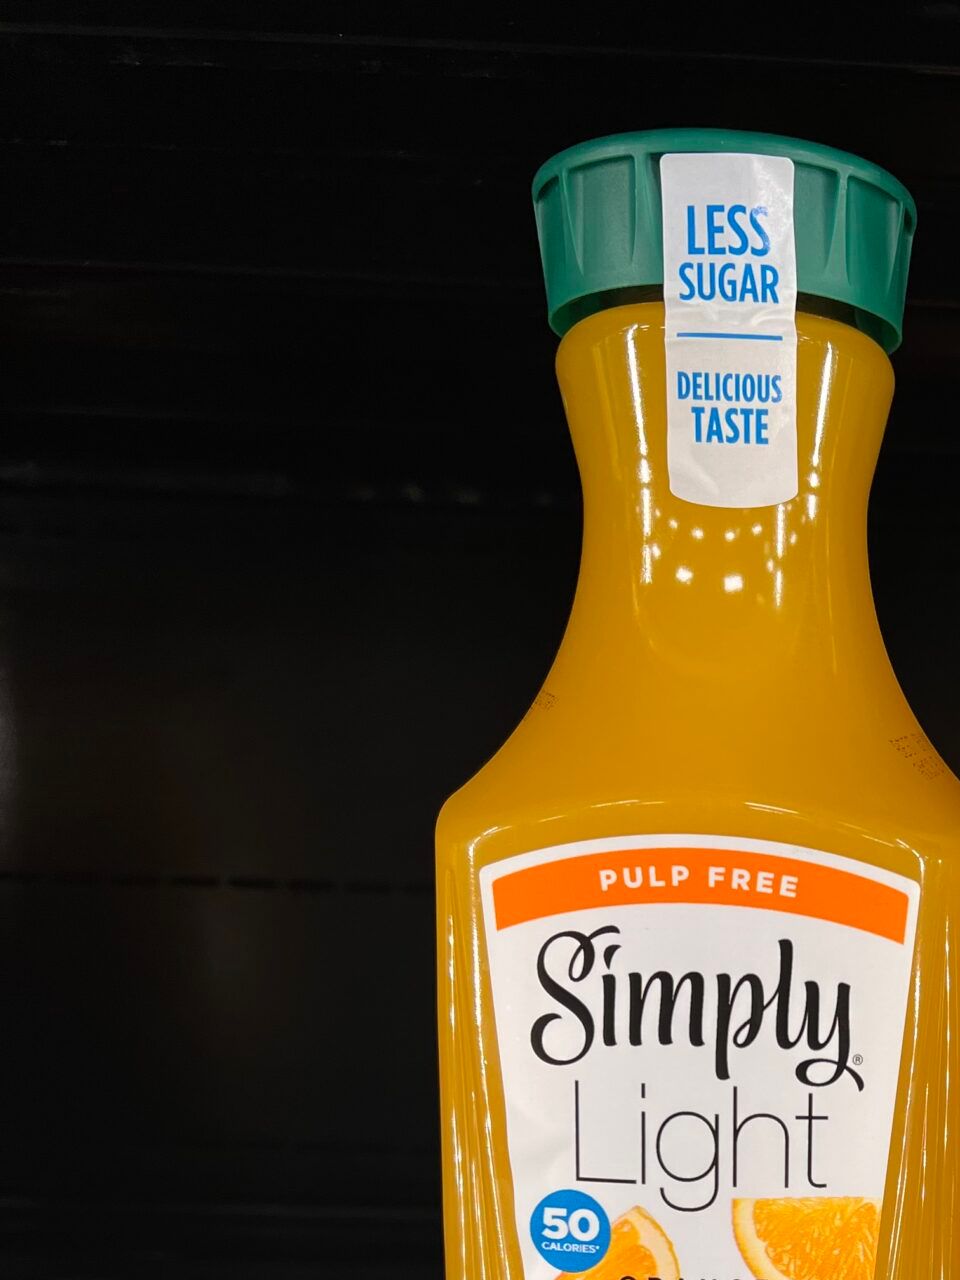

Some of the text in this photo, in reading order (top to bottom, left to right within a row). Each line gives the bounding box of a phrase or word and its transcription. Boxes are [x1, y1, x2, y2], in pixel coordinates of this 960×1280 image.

[687, 204, 771, 257] LESS
[679, 262, 779, 304] SUGAR
[677, 371, 783, 403] DELICIOUS
[691, 407, 769, 445] TASTE
[600, 865, 799, 898] PULP FREE
[530, 925, 864, 1091] Simply
[573, 1080, 828, 1213] Light
[541, 1207, 599, 1239] 50
